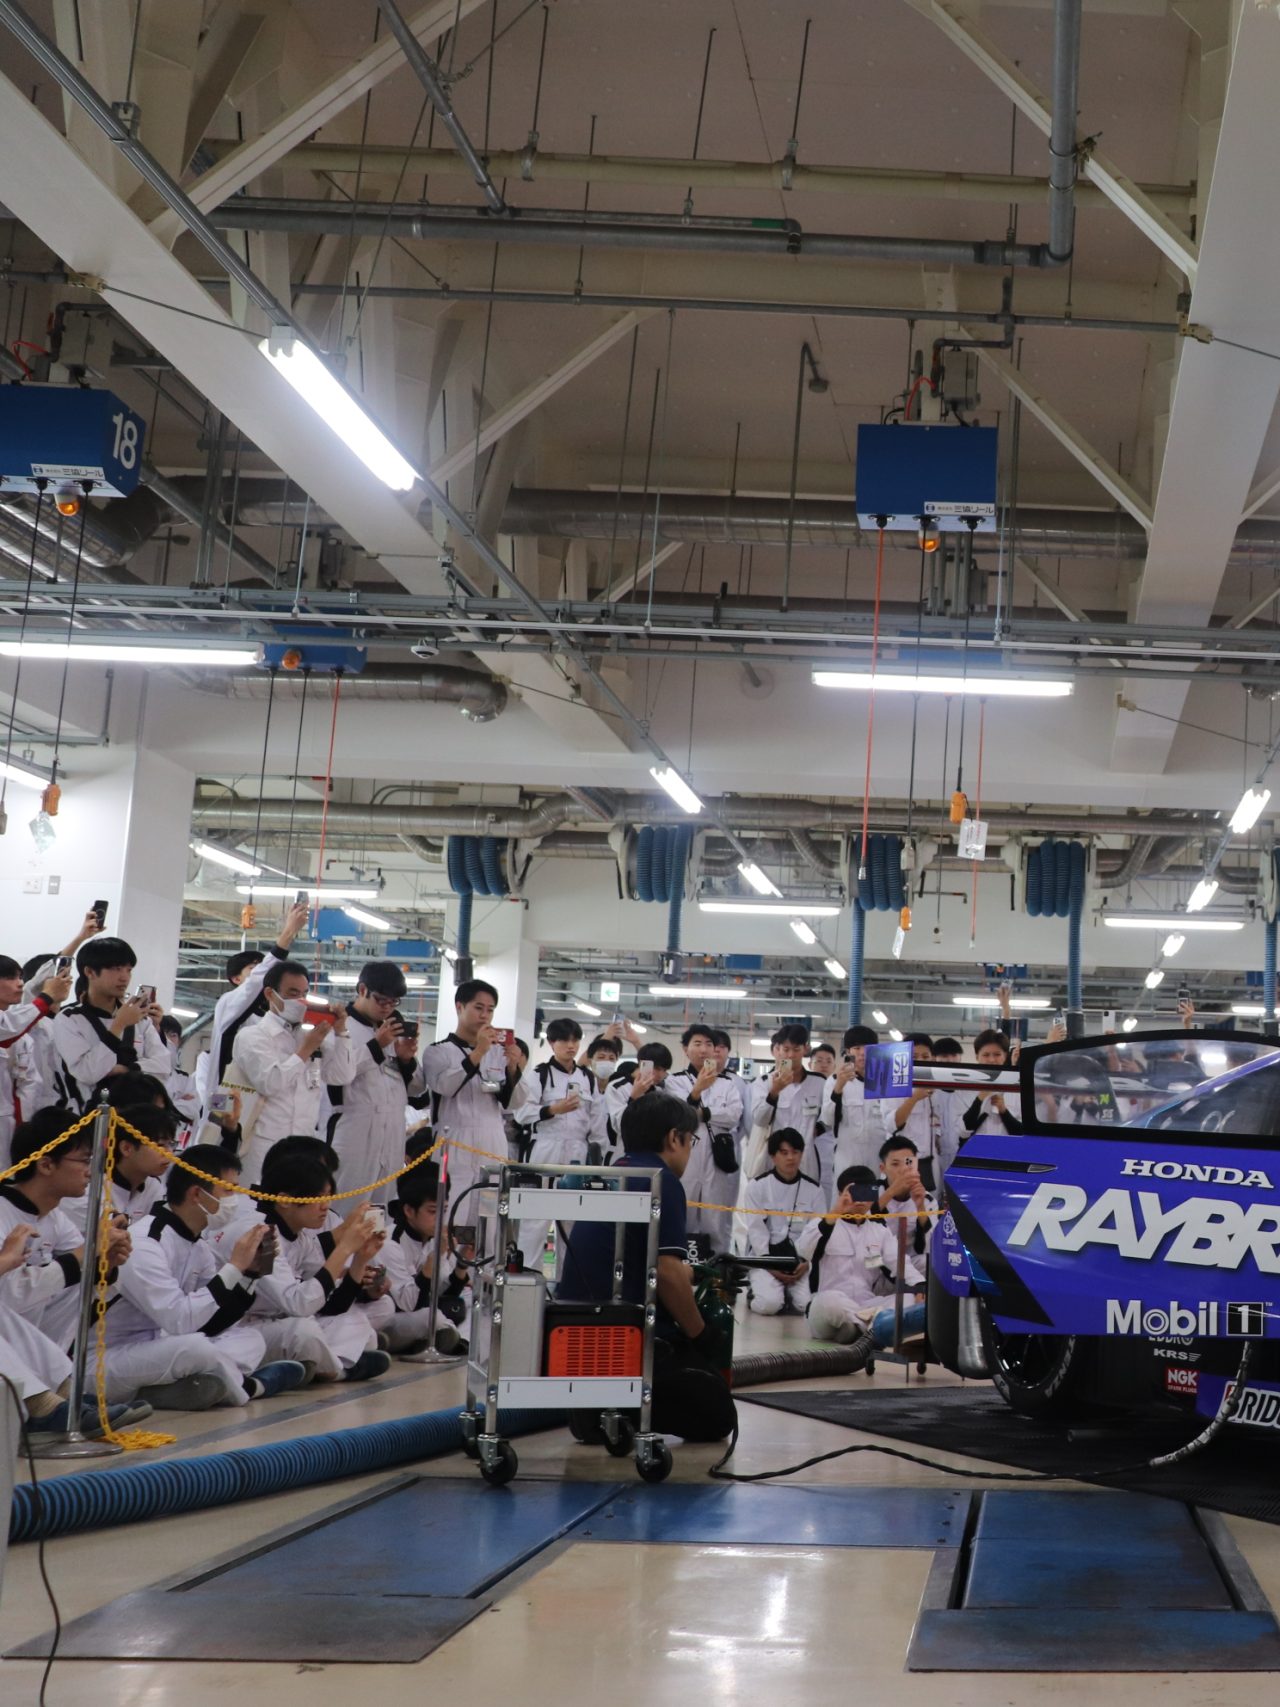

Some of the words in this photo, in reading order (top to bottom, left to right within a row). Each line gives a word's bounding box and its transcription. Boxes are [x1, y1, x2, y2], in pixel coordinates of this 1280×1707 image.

[112, 412, 138, 470] 18
[1120, 1158, 1274, 1189] HONDA
[1106, 1300, 1218, 1336] Mobil
[1154, 1348, 1188, 1361] KRS
[1167, 1368, 1197, 1386] NGK
